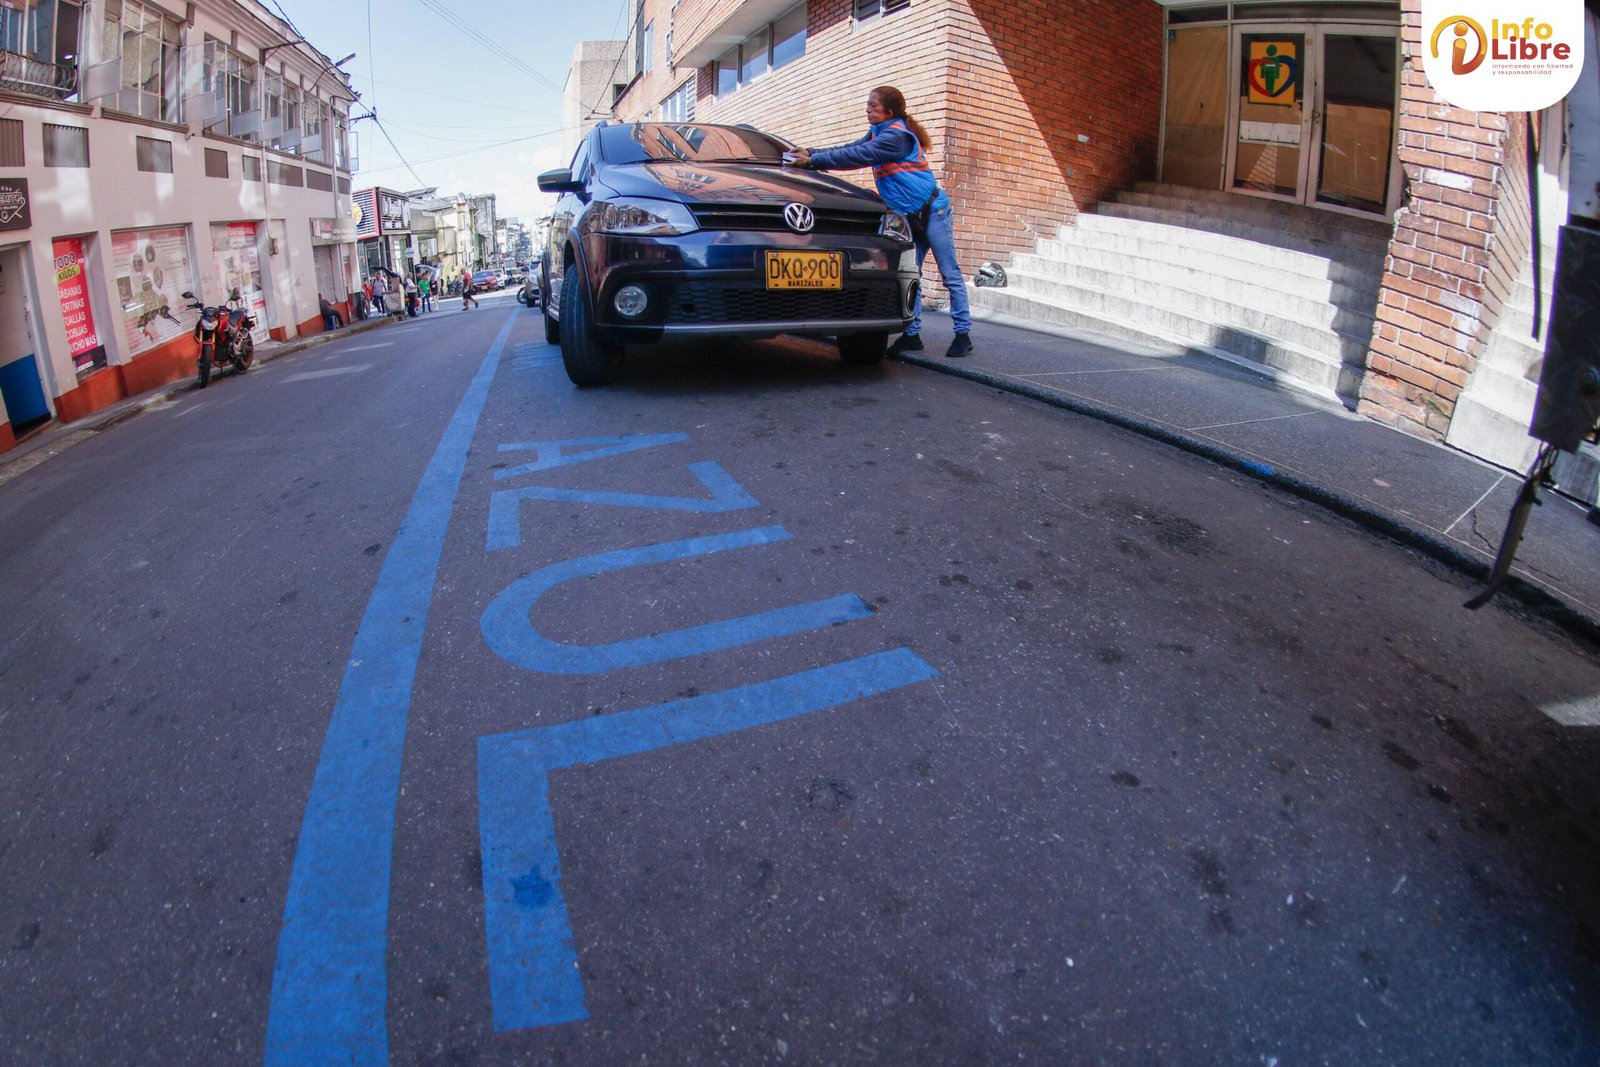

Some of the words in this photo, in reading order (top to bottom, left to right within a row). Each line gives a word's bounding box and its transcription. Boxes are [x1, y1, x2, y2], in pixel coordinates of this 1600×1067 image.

[57, 266, 77, 281] KILOS
[788, 279, 823, 287] MANIZALES
[61, 298, 85, 313] ORTINAS
[84, 333, 97, 347] MÁS
[477, 433, 941, 1033] AZUL
